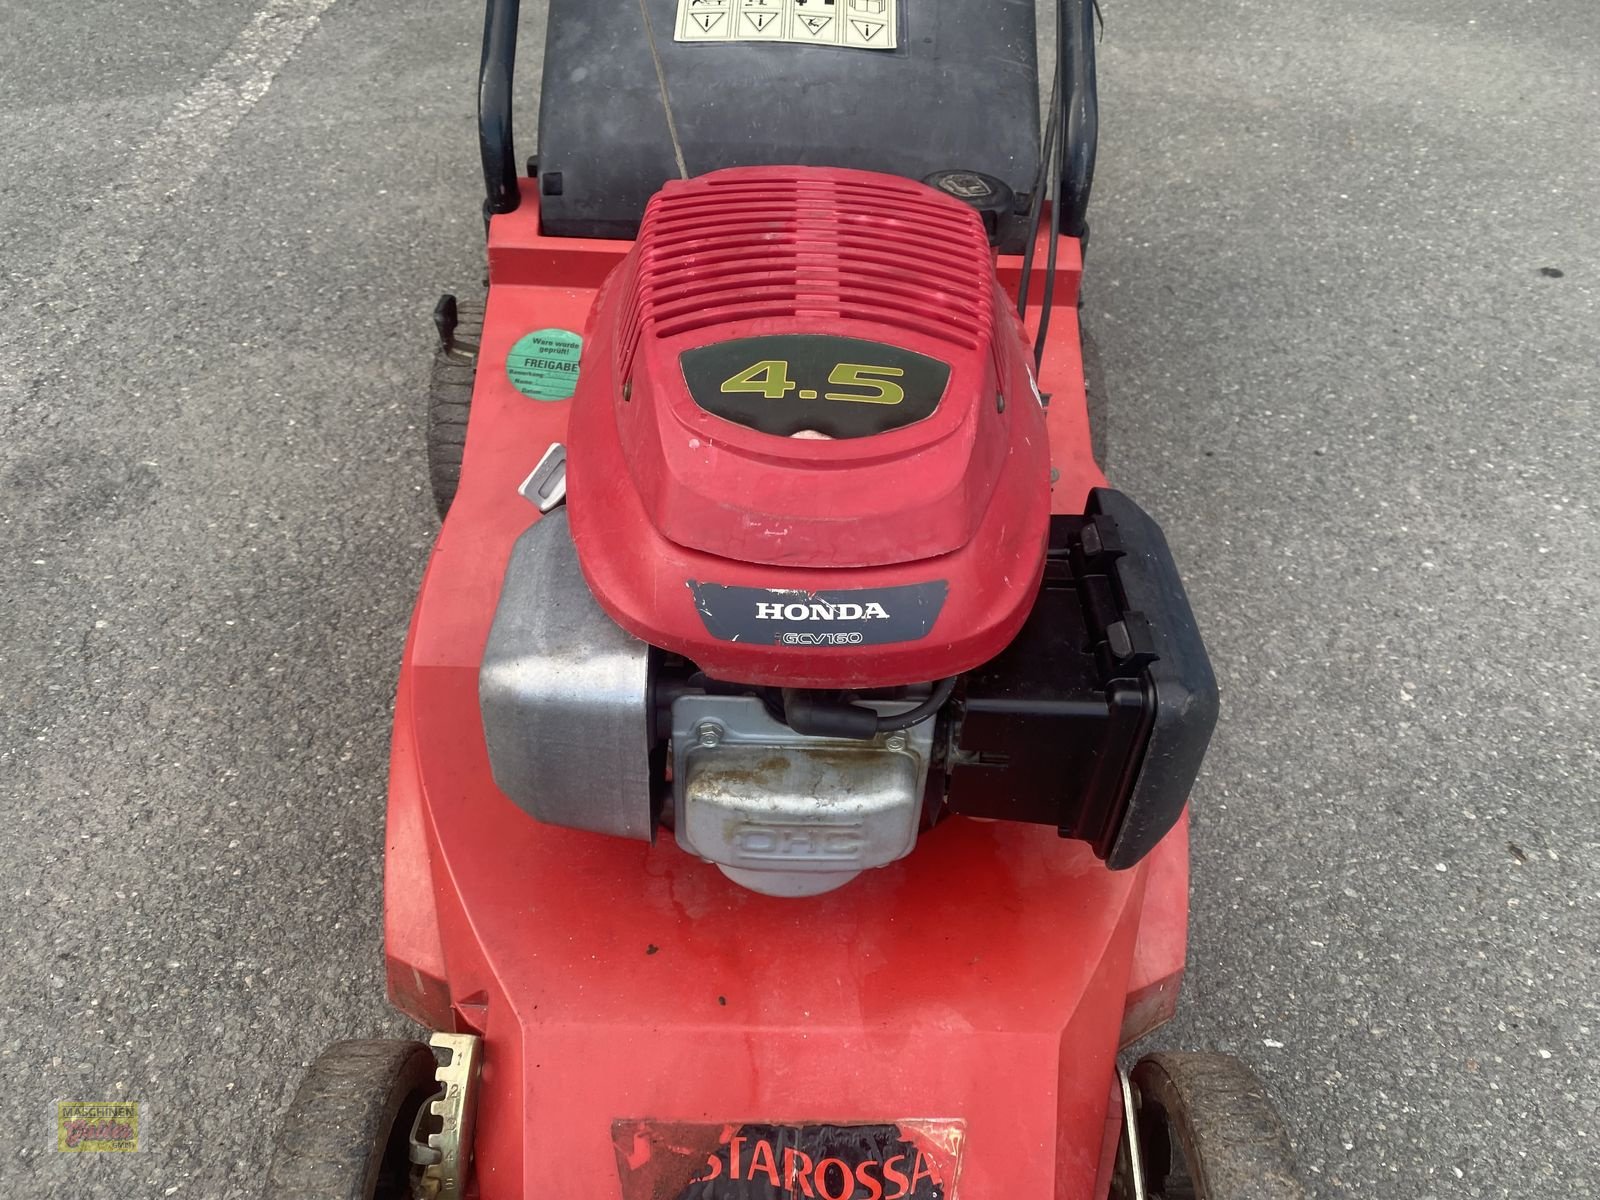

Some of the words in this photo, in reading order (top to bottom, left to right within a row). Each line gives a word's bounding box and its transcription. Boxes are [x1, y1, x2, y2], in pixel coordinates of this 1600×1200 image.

[532, 338, 554, 347] Ware
[555, 341, 580, 349] wurde
[524, 358, 579, 373] FREIGABE
[720, 360, 905, 405] 4.5
[755, 602, 890, 621] HONDA
[782, 632, 864, 645] GCV160
[450, 1083, 460, 1098] 2
